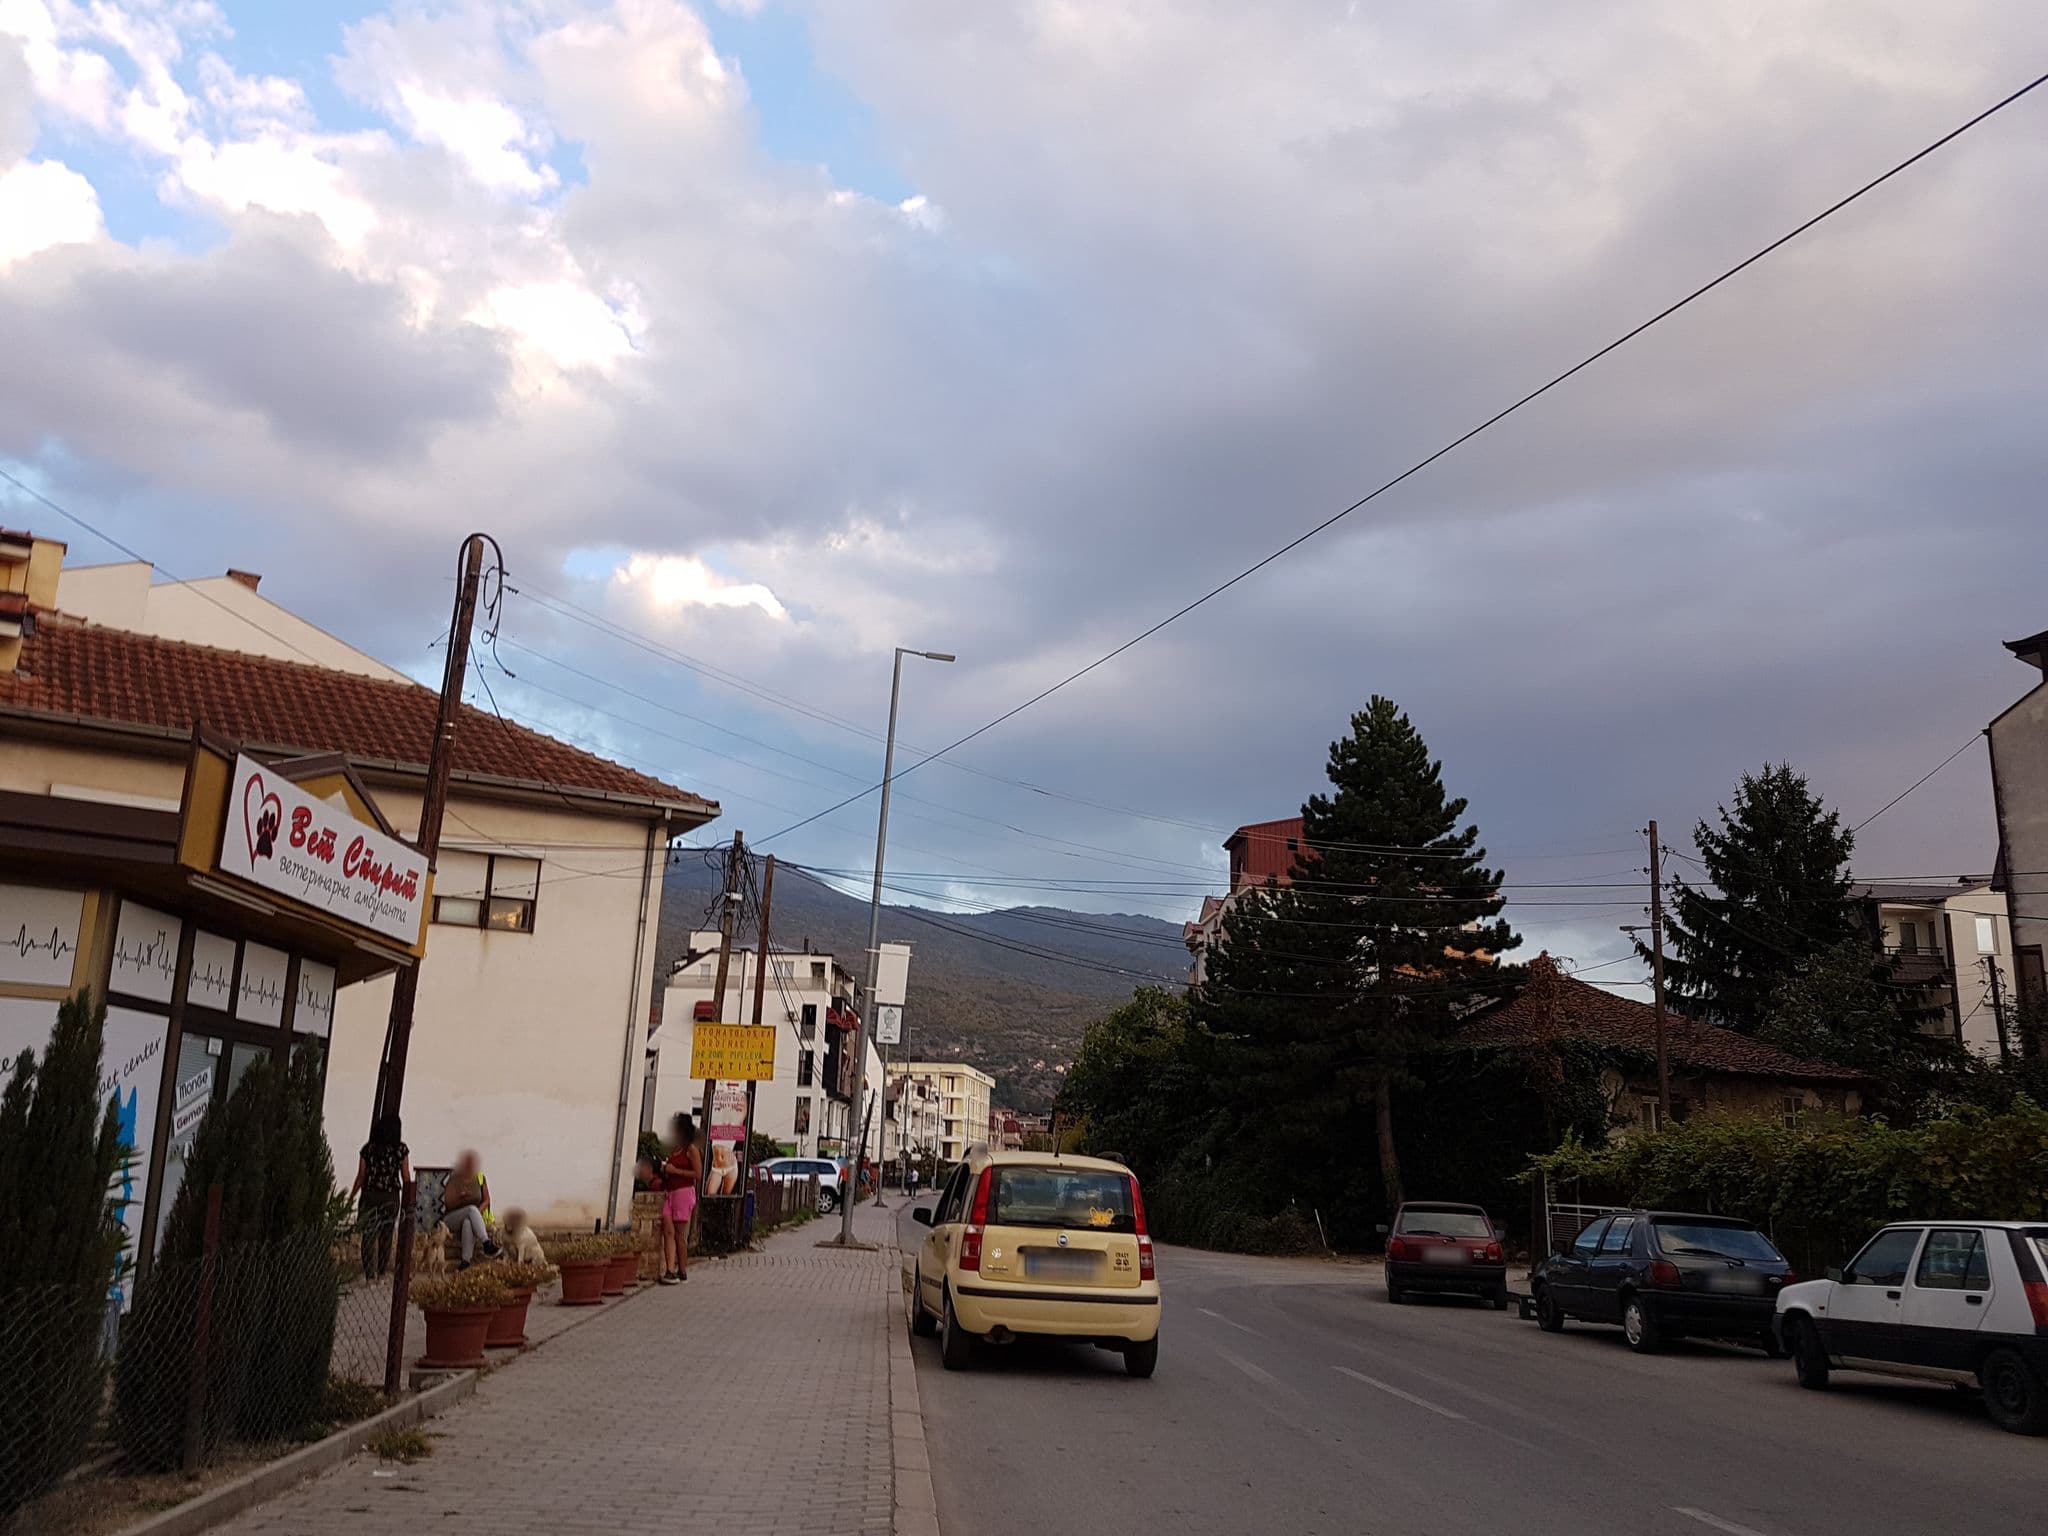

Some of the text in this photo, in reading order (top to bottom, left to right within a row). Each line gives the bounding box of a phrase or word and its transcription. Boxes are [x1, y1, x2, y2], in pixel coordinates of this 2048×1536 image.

[289, 806, 419, 902] Вет Спирит
[279, 855, 406, 923] ветеринарна амбуланта
[99, 1037, 162, 1101] pet center
[699, 1060, 760, 1071] DENTIST
